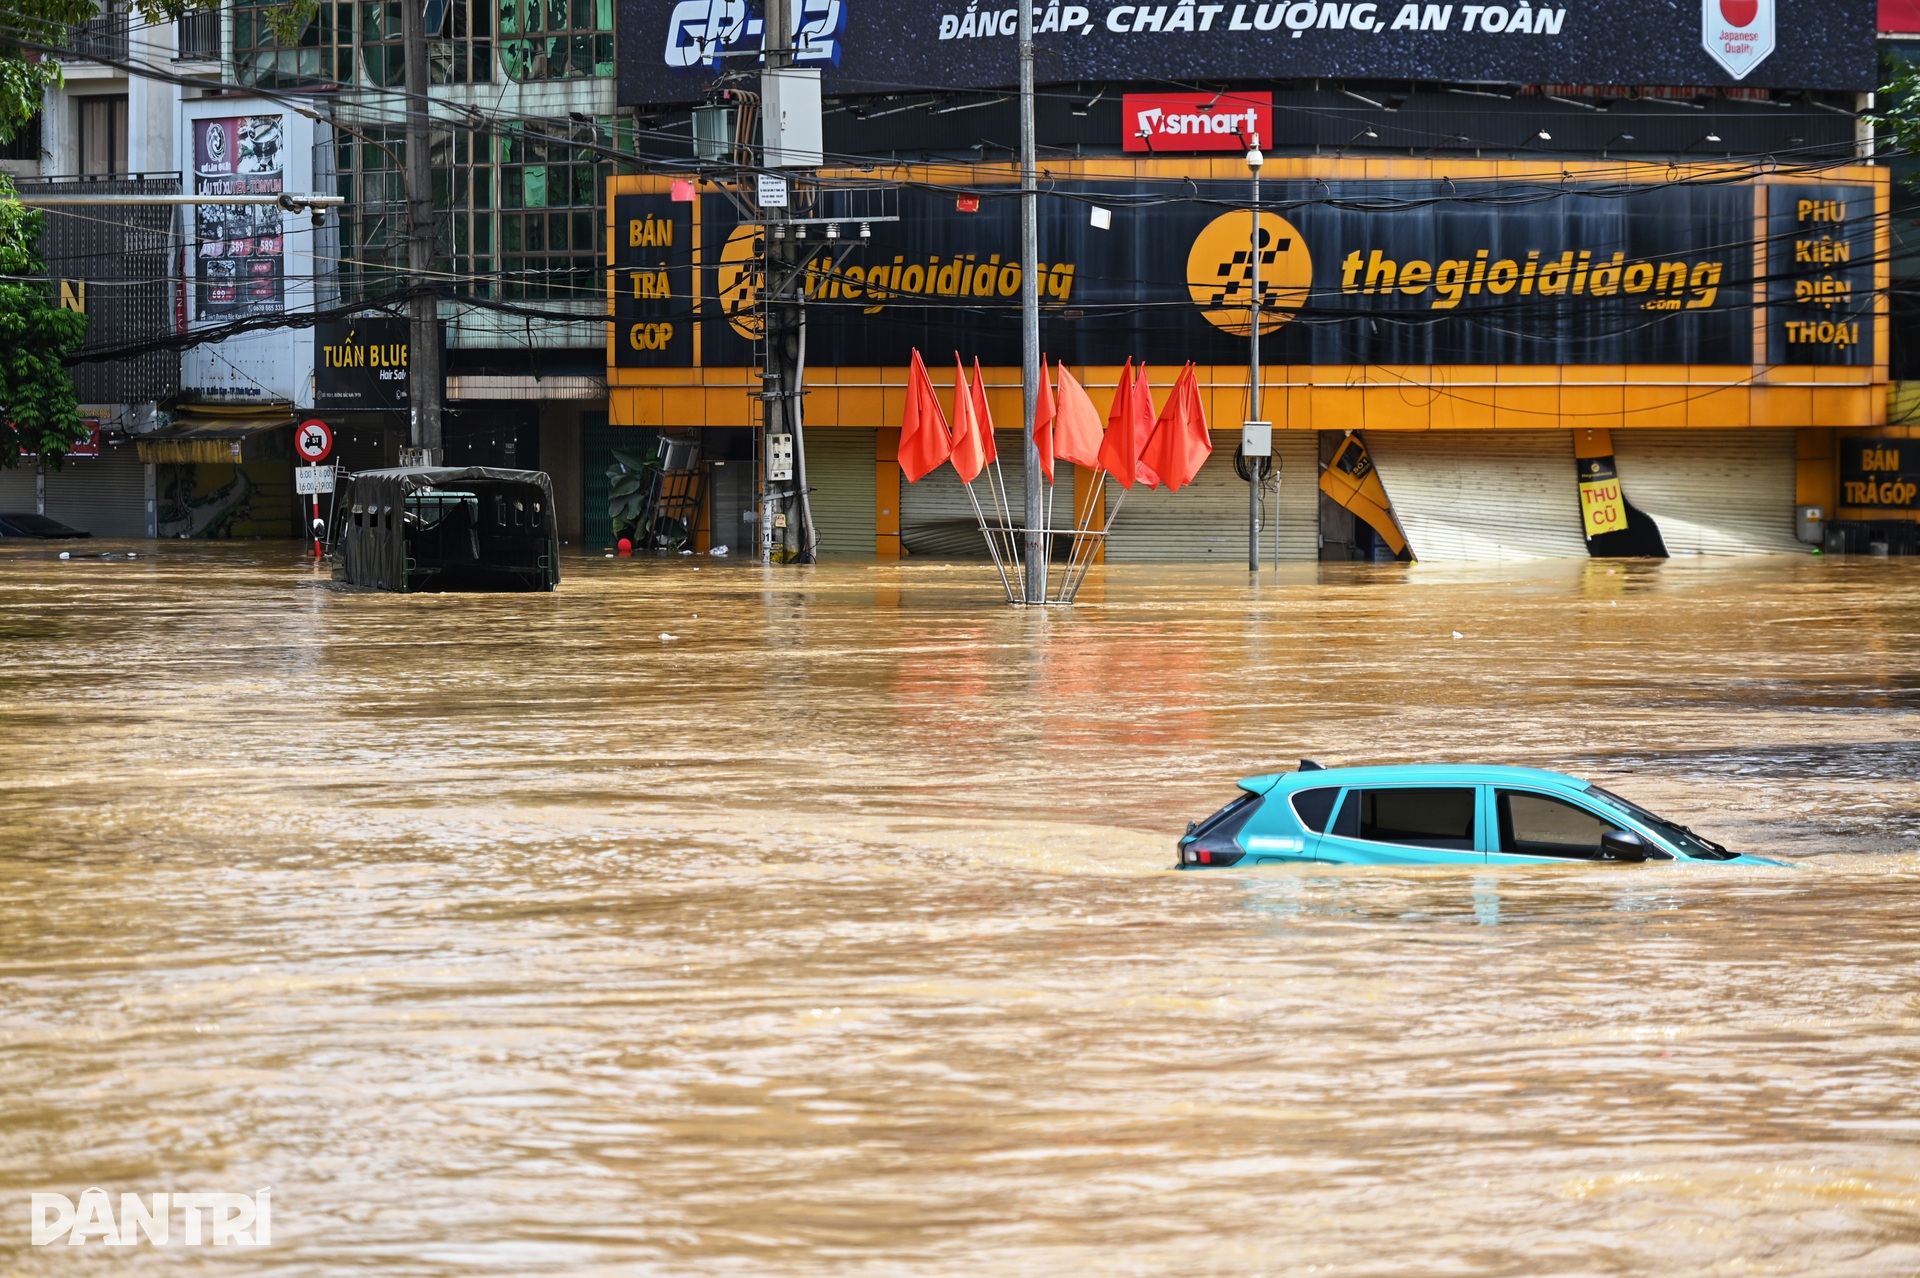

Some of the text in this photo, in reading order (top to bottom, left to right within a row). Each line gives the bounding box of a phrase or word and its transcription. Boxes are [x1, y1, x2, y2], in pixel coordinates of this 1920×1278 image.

[1390, 3, 1453, 31] AN
[1461, 0, 1567, 35] TOÀN
[664, 0, 846, 69] GP-2
[1719, 30, 1759, 42] Japanese
[1725, 42, 1754, 56] Quality
[629, 213, 673, 247] BÁN
[1795, 235, 1851, 268] KIỆN
[630, 261, 672, 299] TRẢ
[1341, 249, 1723, 310] thegioididong
[1795, 275, 1852, 309] ĐIỆN
[1640, 300, 1682, 311] .com
[323, 329, 365, 368] TUẤN
[1785, 320, 1859, 350] THOẠI
[379, 369, 393, 381] Hair
[1862, 444, 1899, 472] BÁN
[298, 482, 315, 491] 16:00
[1582, 485, 1618, 504] THU
[1844, 475, 1918, 505] TRẢ GÓP
[1592, 504, 1618, 525] CŨ
